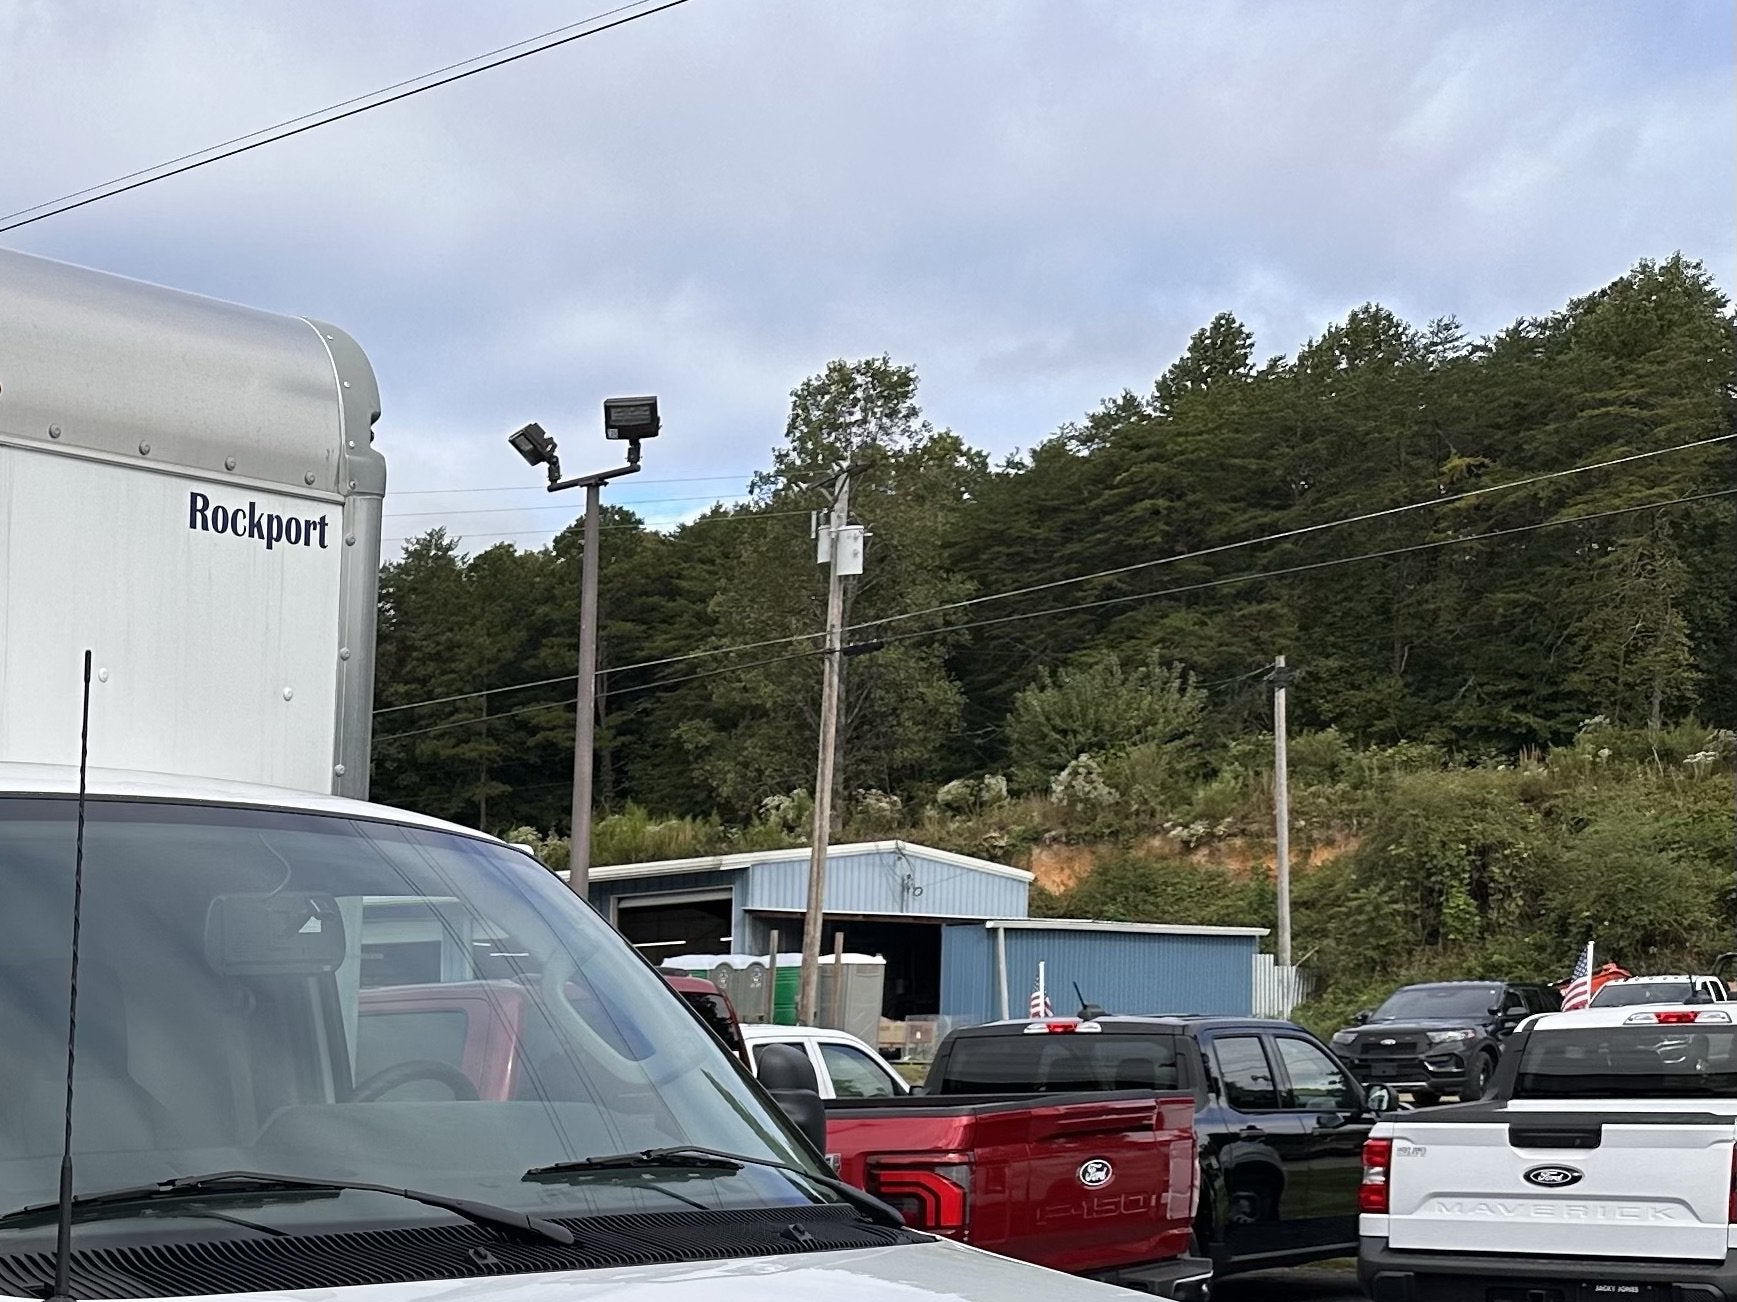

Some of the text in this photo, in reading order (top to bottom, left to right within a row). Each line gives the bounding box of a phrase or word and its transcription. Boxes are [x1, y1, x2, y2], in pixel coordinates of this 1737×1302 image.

[189, 491, 329, 550] Rockport
[1084, 1162, 1108, 1182] Ford
[1434, 1202, 1677, 1221] MAVERICK
